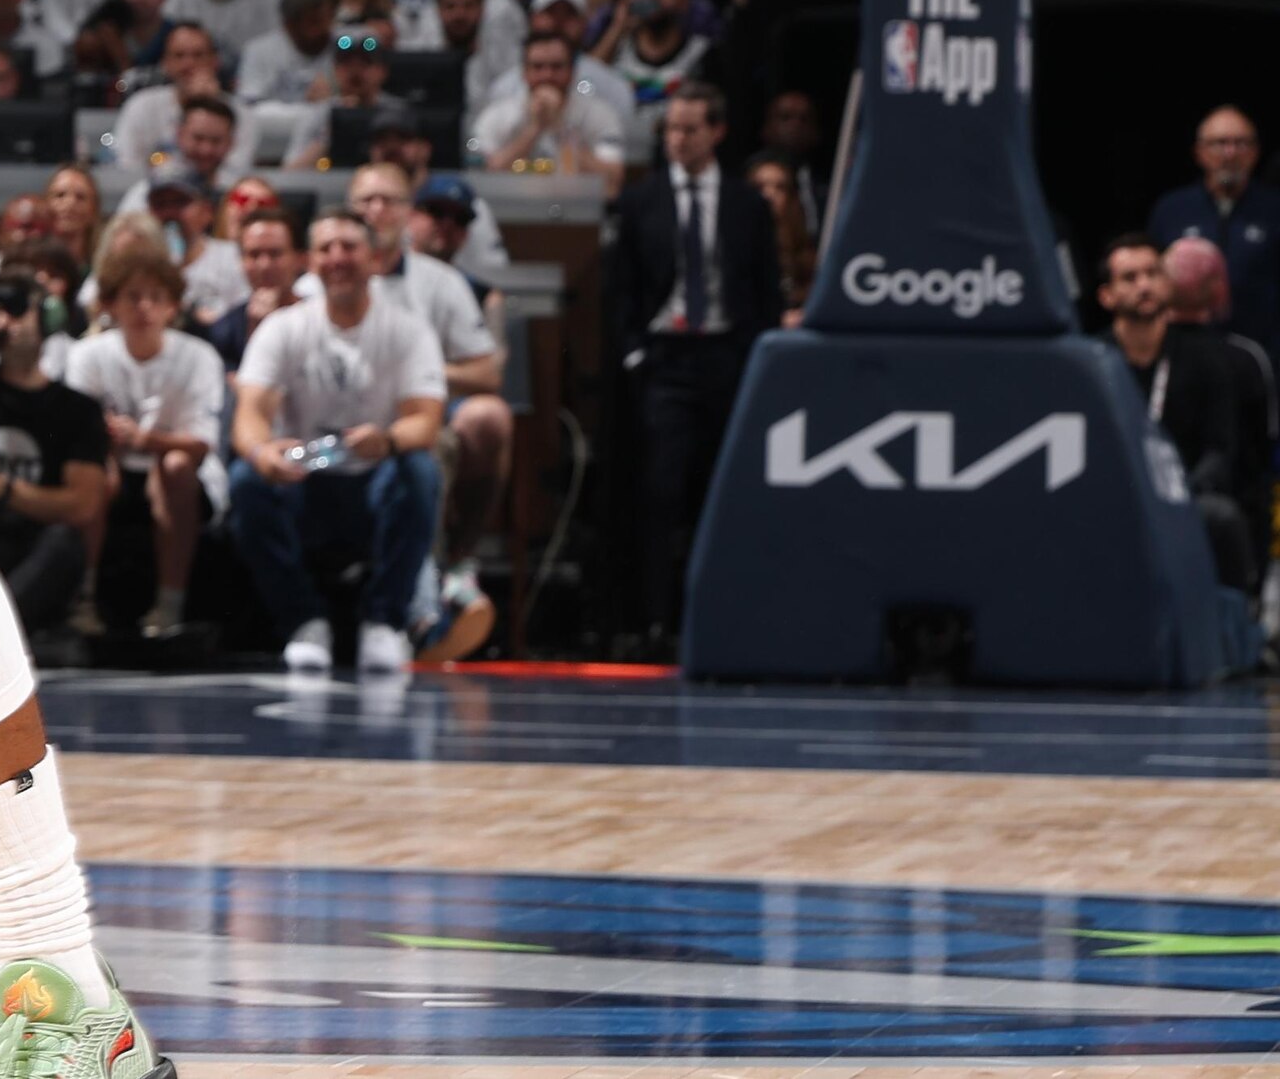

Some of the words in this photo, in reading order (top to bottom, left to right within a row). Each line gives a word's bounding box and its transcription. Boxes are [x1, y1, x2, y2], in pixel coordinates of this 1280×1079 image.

[920, 22, 997, 106] App
[843, 253, 1024, 318] Google
[765, 409, 1086, 490] KIA
